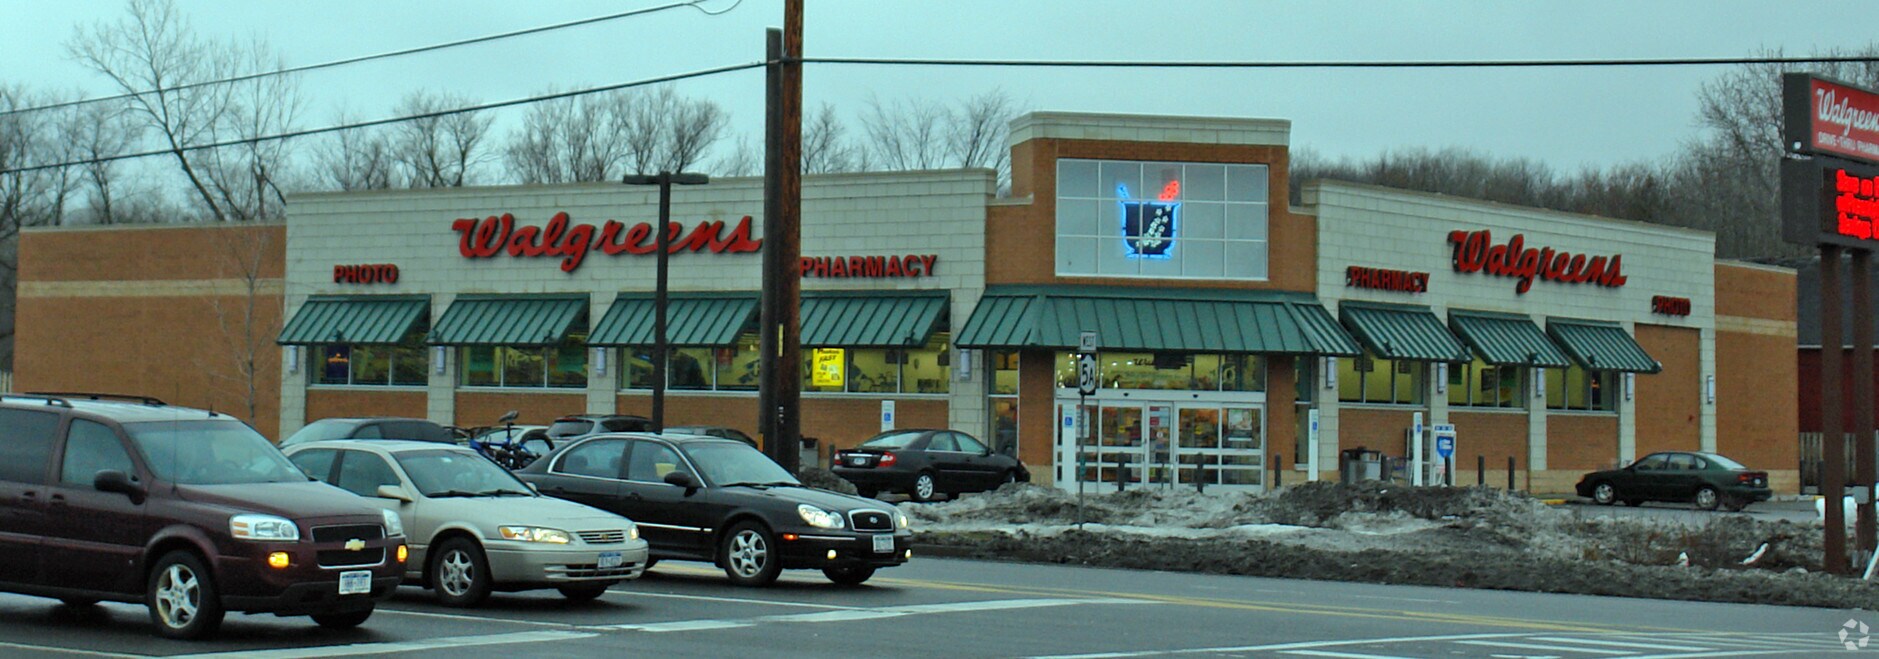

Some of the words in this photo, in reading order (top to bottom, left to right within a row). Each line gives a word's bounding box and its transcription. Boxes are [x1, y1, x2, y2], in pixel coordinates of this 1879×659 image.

[452, 211, 763, 273] Walgreens
[333, 263, 400, 284] PHOTO
[800, 254, 938, 278] PHARMACY
[1448, 229, 1628, 295] Walgreens
[1346, 266, 1430, 292] PHARMACY
[1652, 295, 1691, 317] PHOTO
[1082, 363, 1095, 386] 5A
